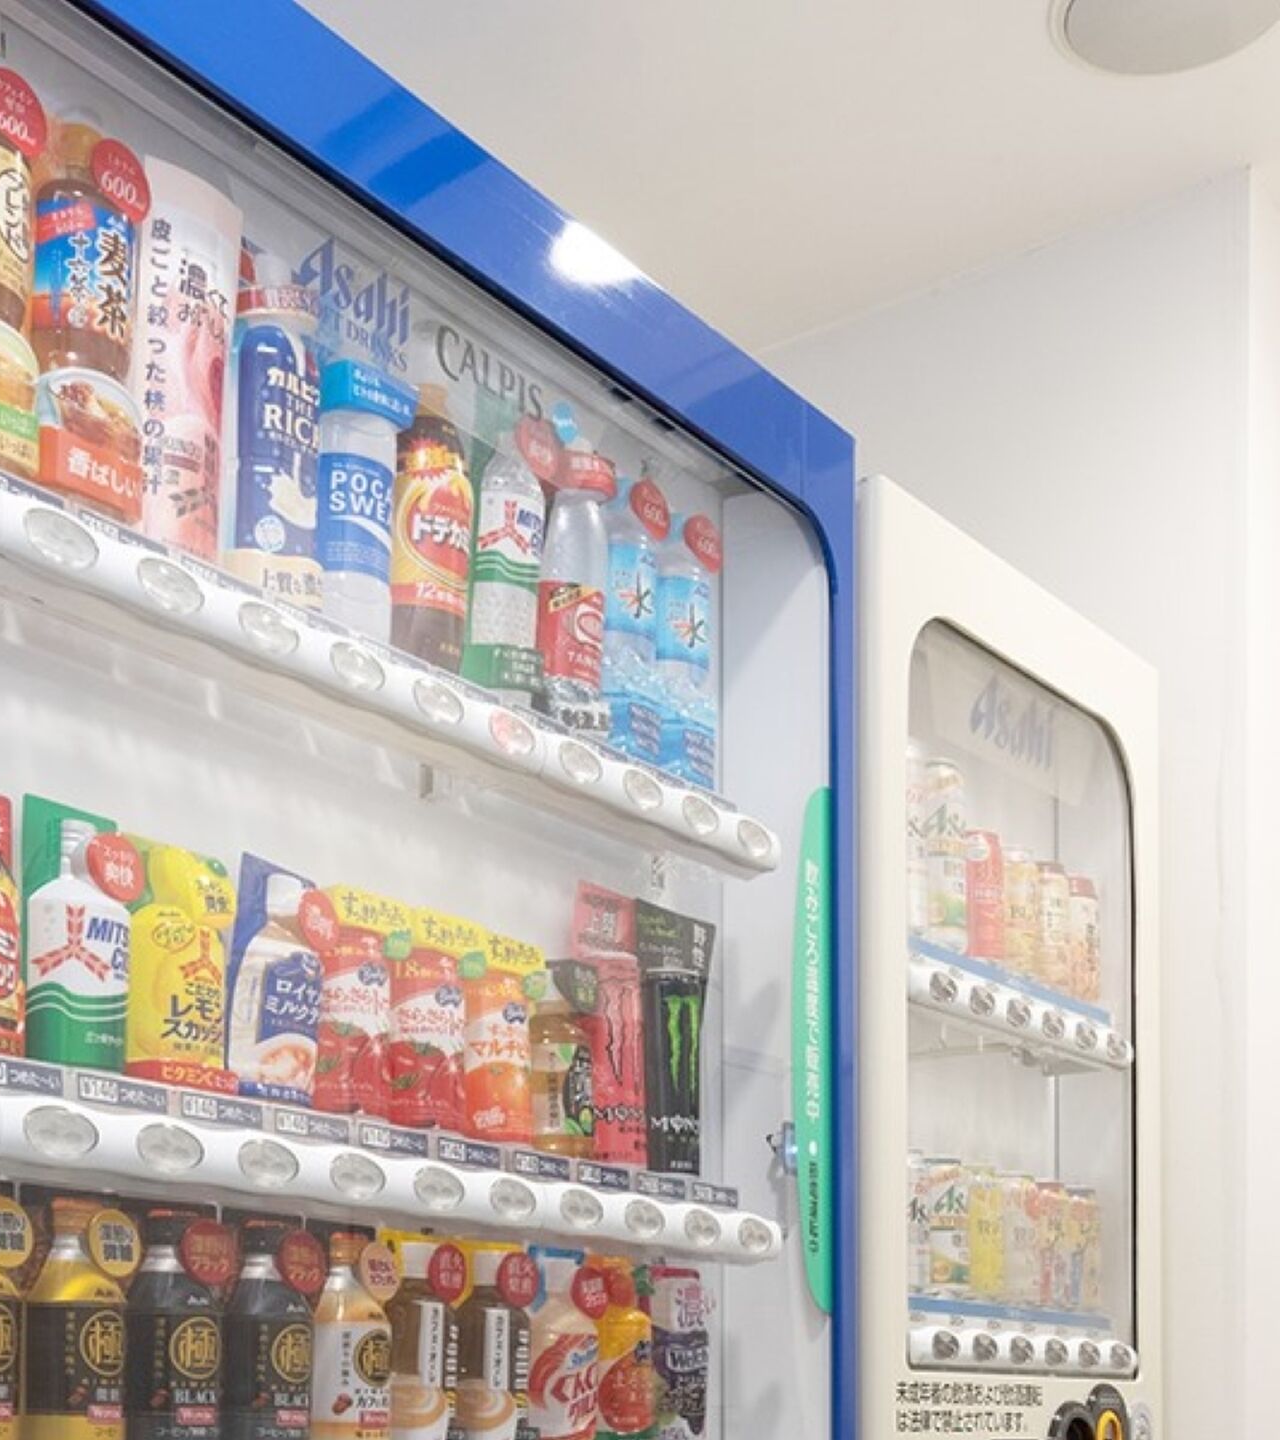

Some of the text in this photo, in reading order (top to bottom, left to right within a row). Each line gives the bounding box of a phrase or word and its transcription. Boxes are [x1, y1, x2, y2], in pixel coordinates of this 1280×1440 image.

[100, 170, 137, 205] 600
[97, 229, 128, 338] 麦茶
[436, 324, 542, 422] CALPIS
[67, 446, 139, 499] 香ばしい
